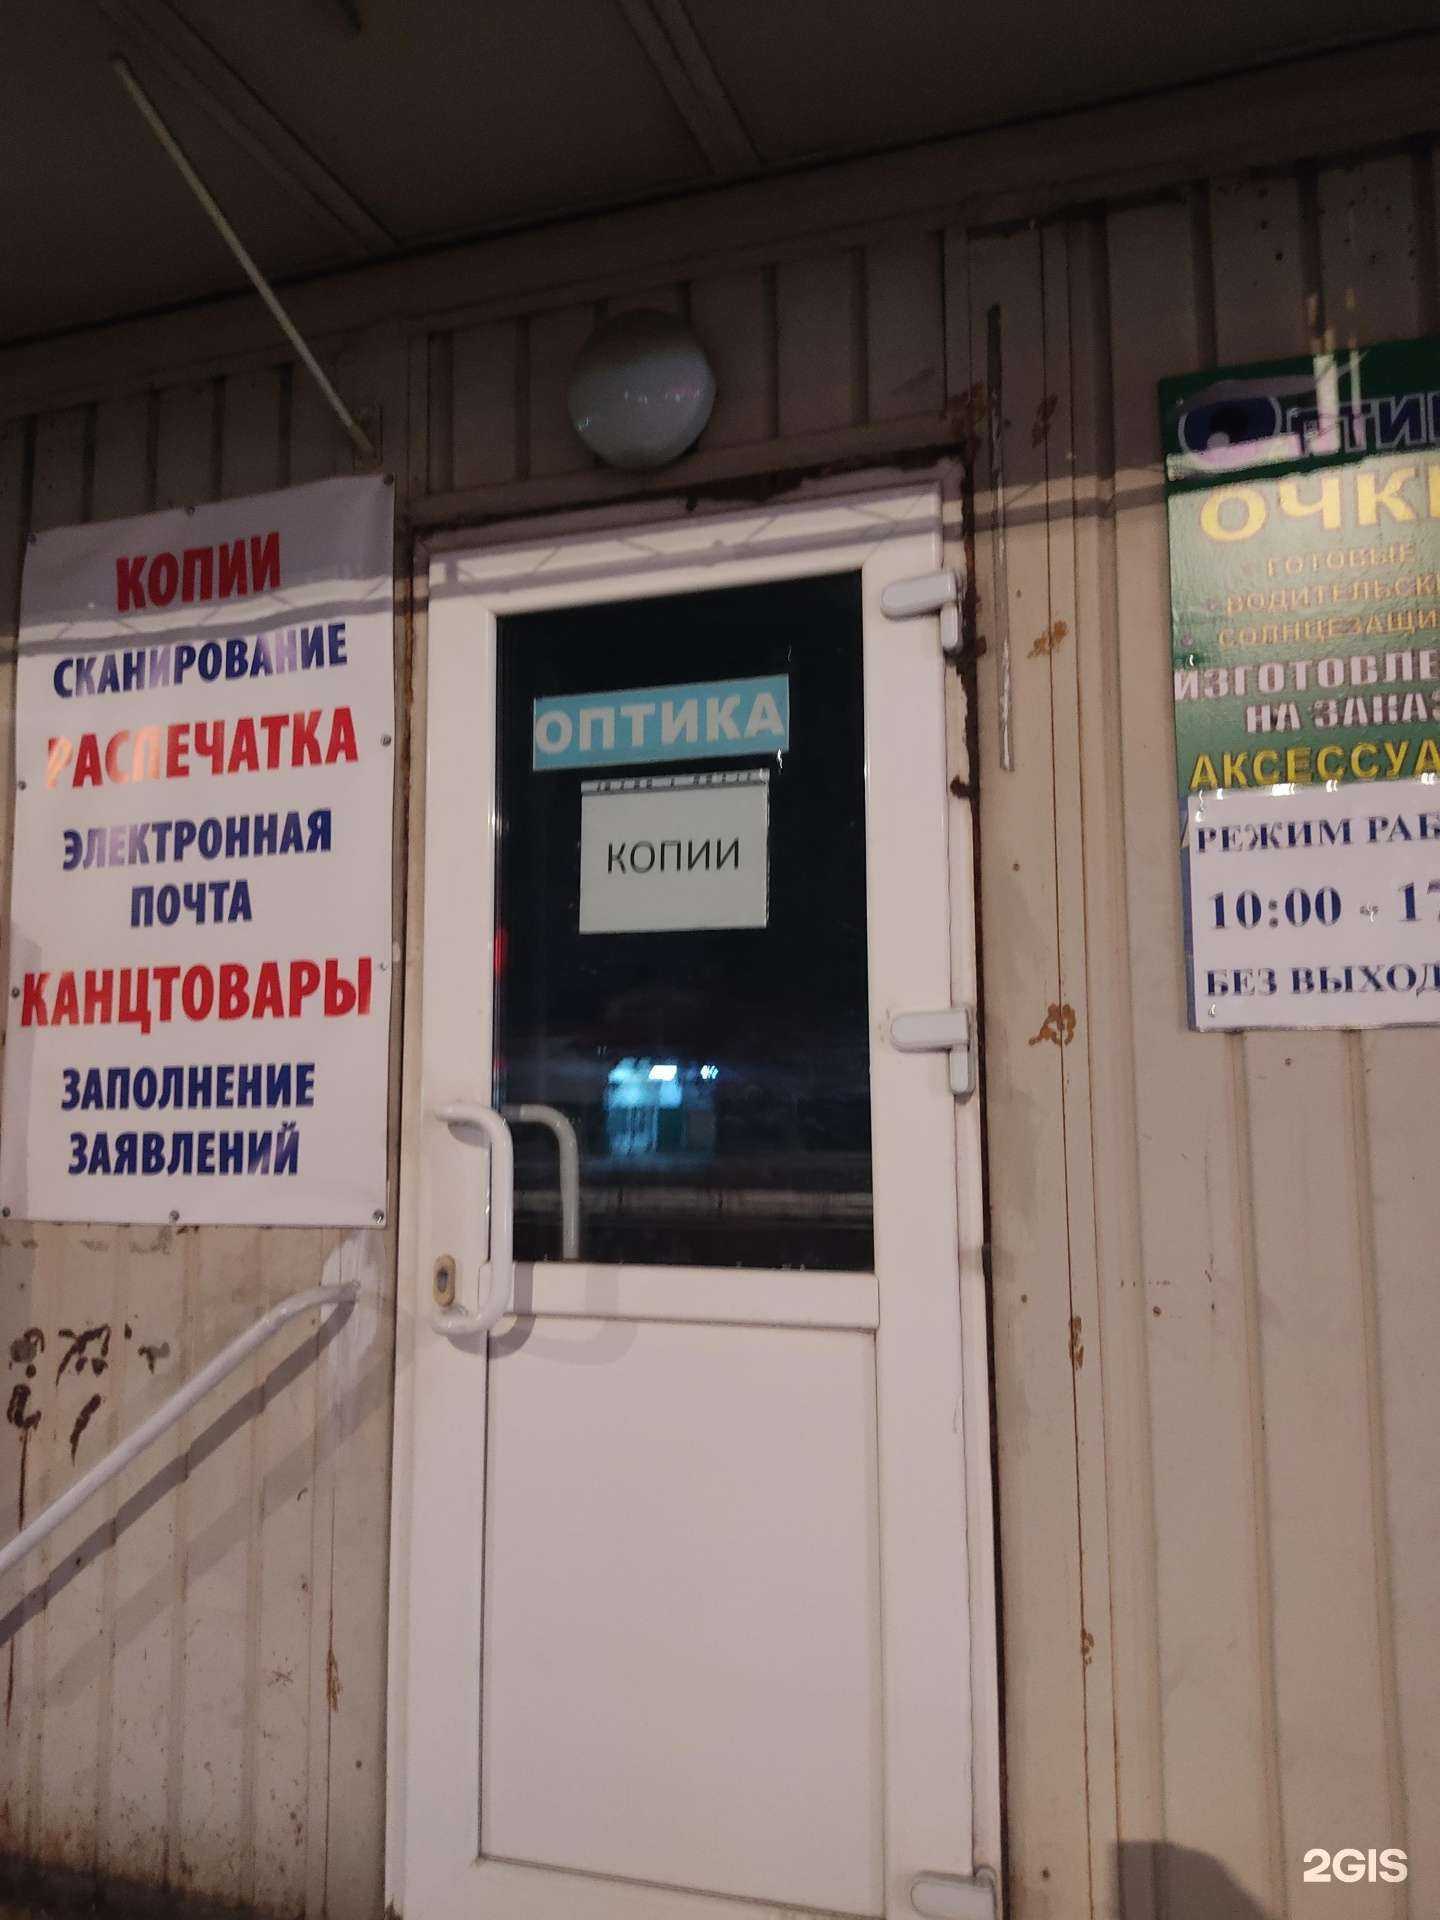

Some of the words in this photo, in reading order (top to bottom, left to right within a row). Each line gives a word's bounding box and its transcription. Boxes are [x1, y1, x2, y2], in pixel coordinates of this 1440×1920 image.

[1201, 463, 1440, 542] ОЧК
[116, 531, 281, 613] КОПИИ
[1226, 570, 1440, 617] РОДИТЕЛЬСК
[53, 622, 348, 698] СКАНИРОВАНИЕ
[535, 692, 785, 754] ОПТИКА
[1246, 702, 1302, 734] НА
[45, 705, 359, 788] РАСПЕЧАТКА
[1190, 739, 1440, 791] АКСЕССУА
[63, 808, 332, 871] ЭЛЕКТРОННАЯ
[607, 837, 740, 874] КОПИИ
[1196, 818, 1353, 853] РЕЖИМ
[130, 879, 253, 929] ПОЧТА
[1208, 886, 1343, 931] 10:00
[20, 956, 373, 1035] КАНЦТОВАРЫ
[1205, 965, 1278, 996] БЕЗ
[61, 1062, 316, 1111] ЗАПОЛНЕНИЕ
[67, 1120, 300, 1177] ЗАЯВЛЕНИЙ
